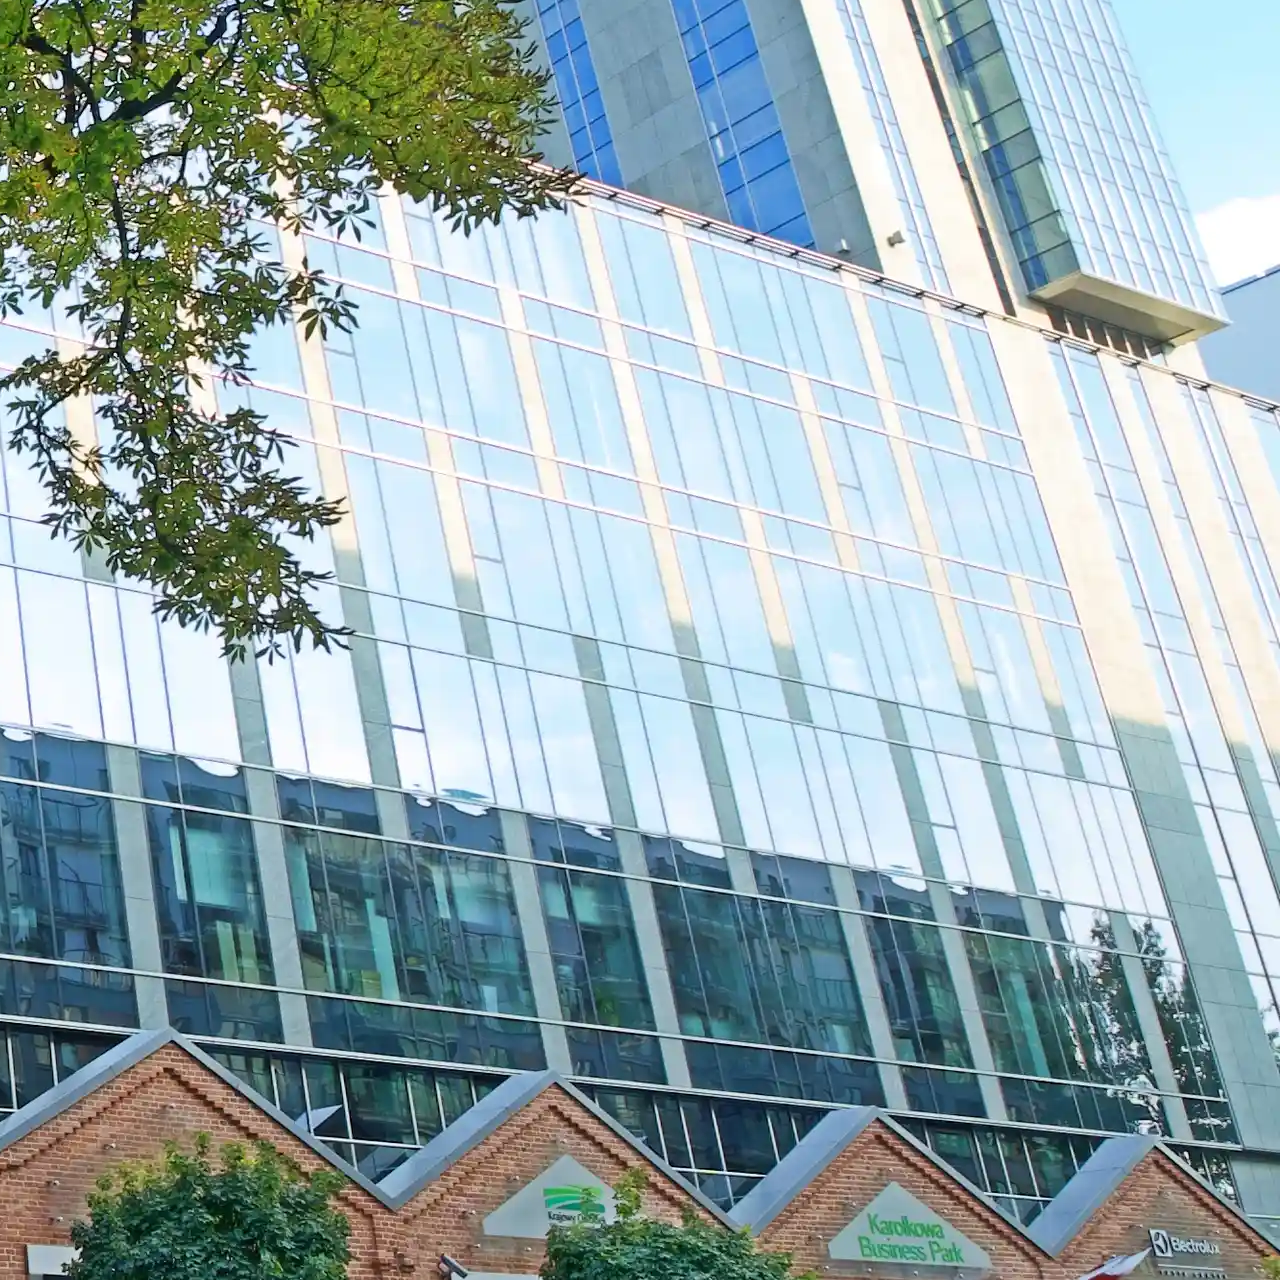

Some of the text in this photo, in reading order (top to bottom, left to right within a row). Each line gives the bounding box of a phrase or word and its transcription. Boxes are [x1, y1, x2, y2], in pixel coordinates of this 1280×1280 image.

[867, 1213, 945, 1239] Karolkowa
[858, 1235, 965, 1263] Business Park
[1169, 1236, 1221, 1255] Electrolux
